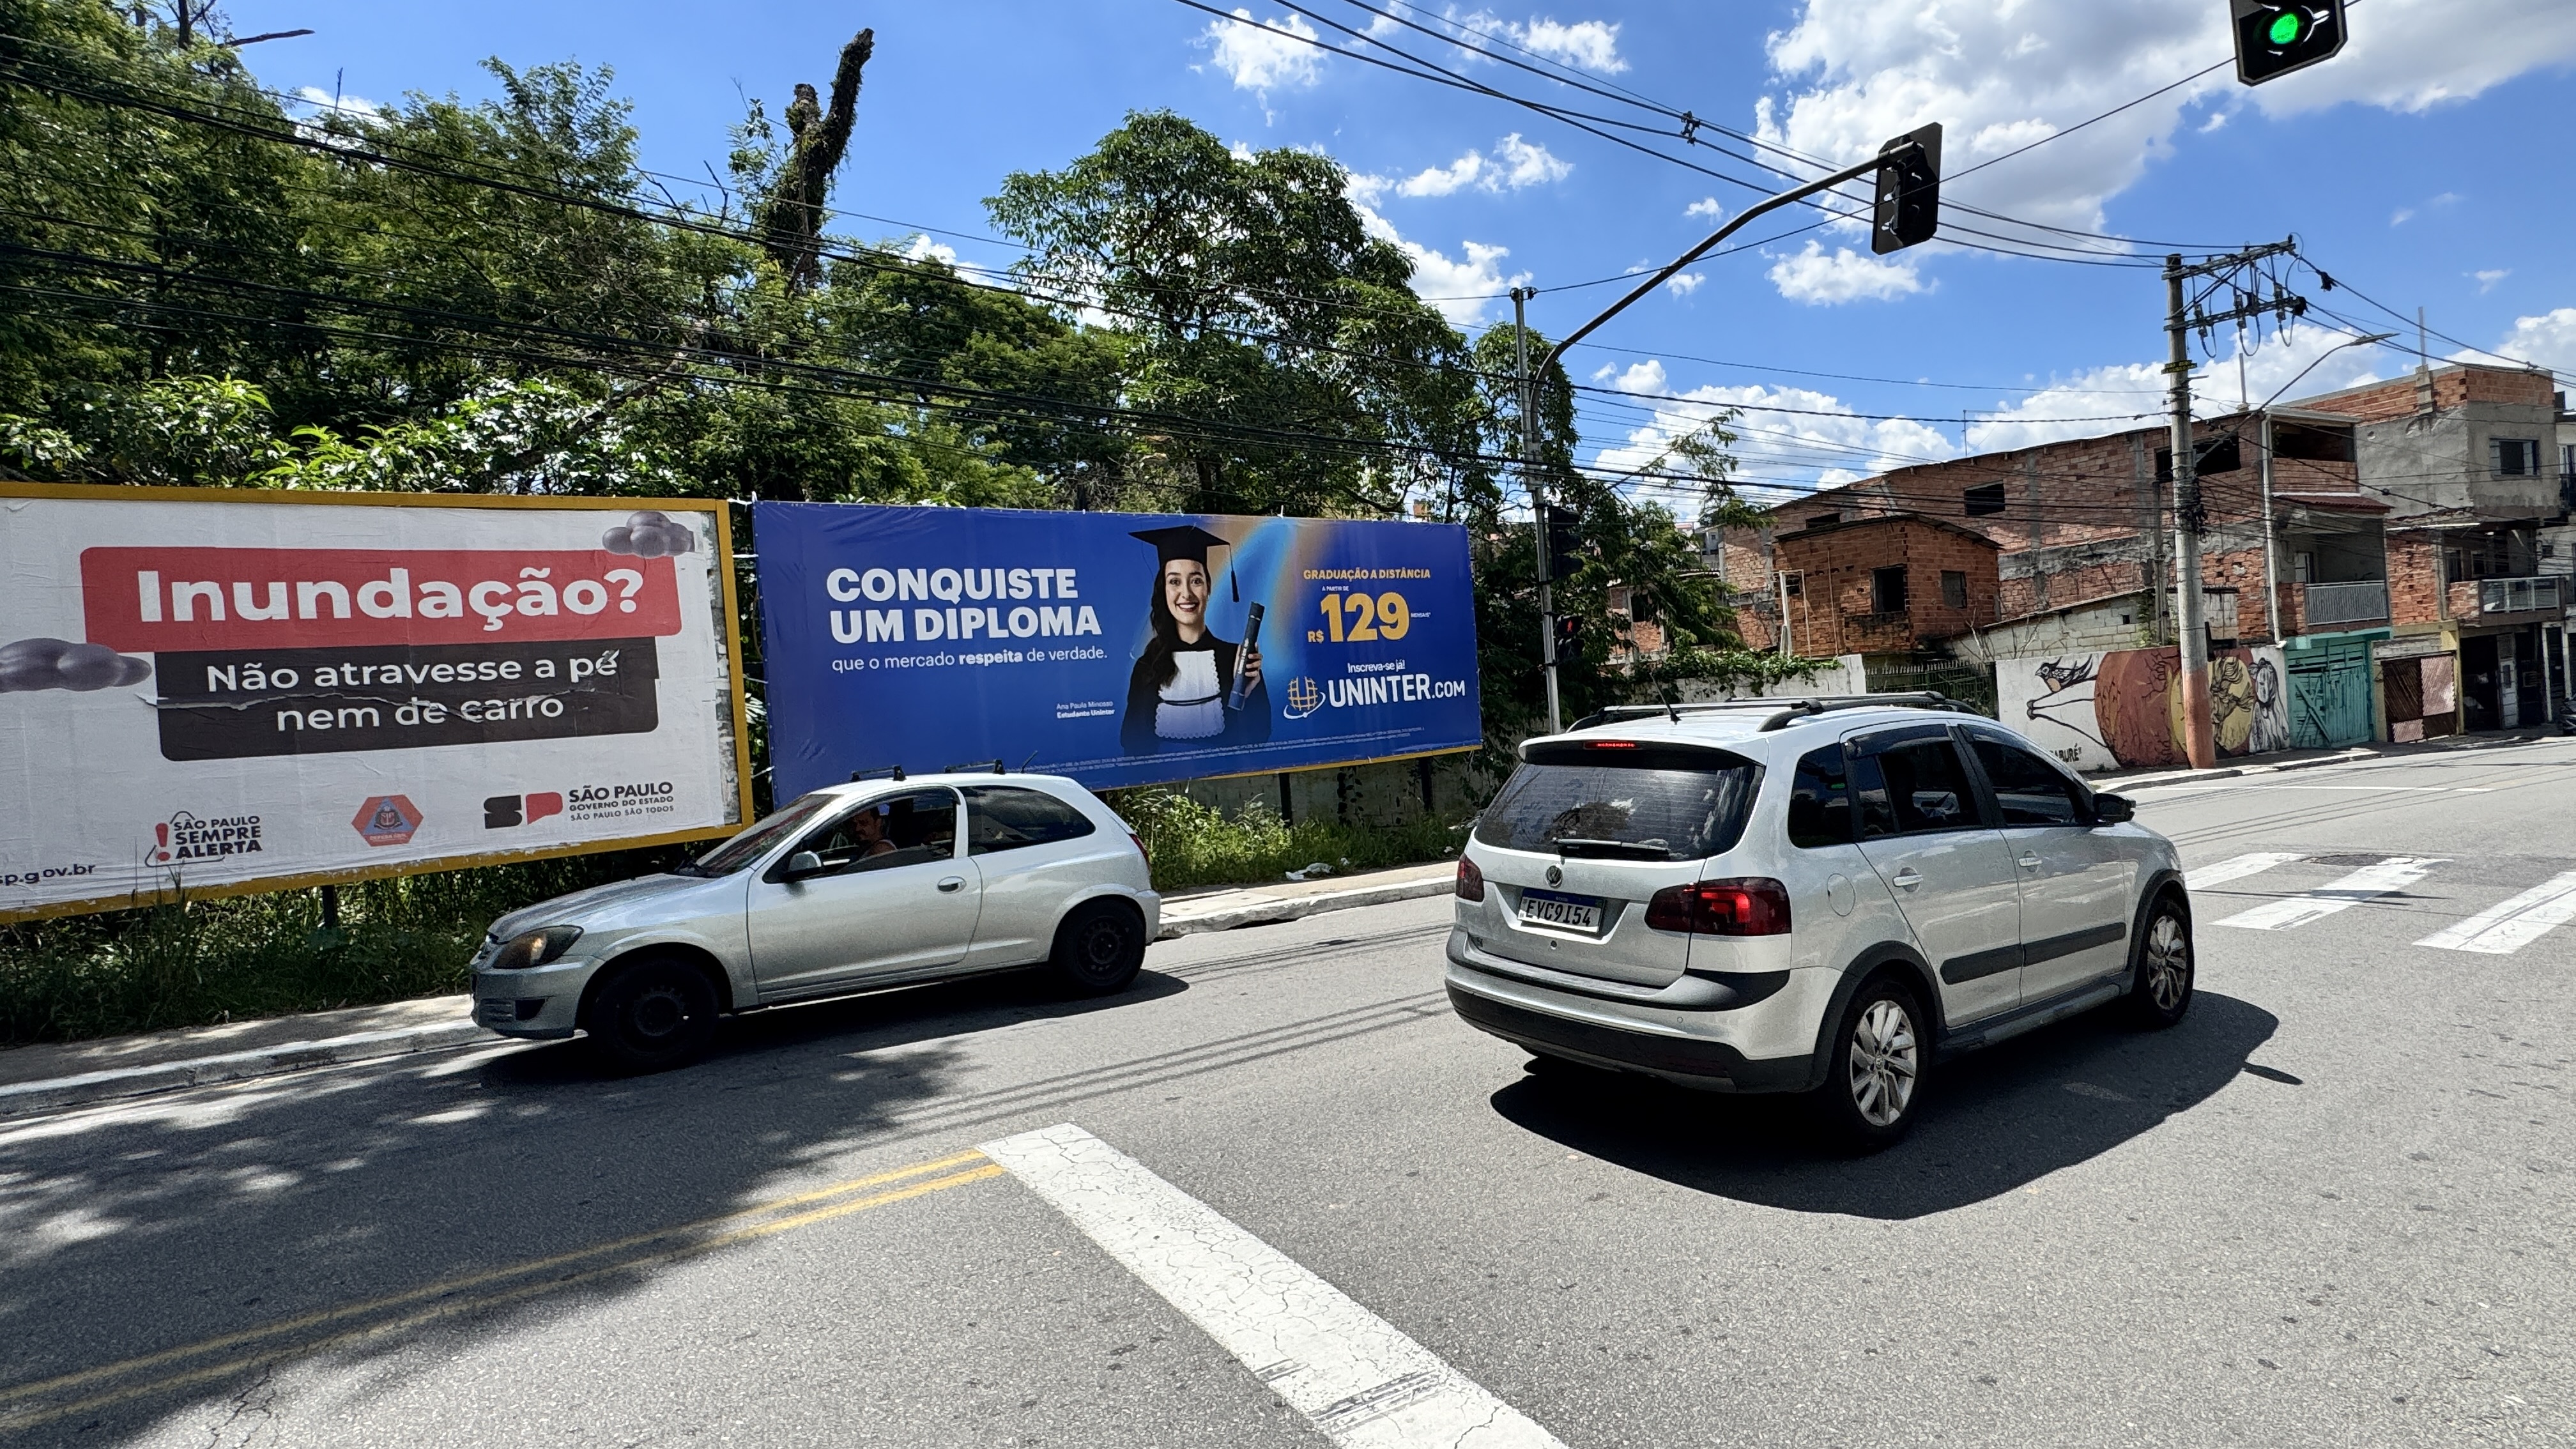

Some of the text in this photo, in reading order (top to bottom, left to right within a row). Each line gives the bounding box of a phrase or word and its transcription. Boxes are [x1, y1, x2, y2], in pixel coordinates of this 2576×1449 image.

[827, 568, 1078, 604] CONQUISTE
[1303, 567, 1430, 582] GRADUAÇÃO A DISTÂNCIA
[138, 567, 643, 631] Inundação?
[831, 606, 1102, 644] UM DIPLOMA
[1308, 629, 1324, 643] R$
[1321, 592, 1409, 642] 129
[207, 649, 619, 692] Não atravesse a pé
[832, 645, 1108, 673] que o mercado respeita de verdade.
[1347, 659, 1406, 673] Inscreva-se já!
[1328, 673, 1466, 707] UNINTER.COM
[277, 696, 564, 731] nem de carro
[569, 781, 673, 803] SÃO PAULO
[569, 801, 618, 811] GOVERNO
[639, 795, 674, 805] ESTADO
[174, 815, 261, 831] SÃO PAULO
[571, 804, 675, 822] SÃO PAULO SÃO TODOS
[175, 825, 261, 845] SEMPRE
[176, 839, 263, 859] ALERTA
